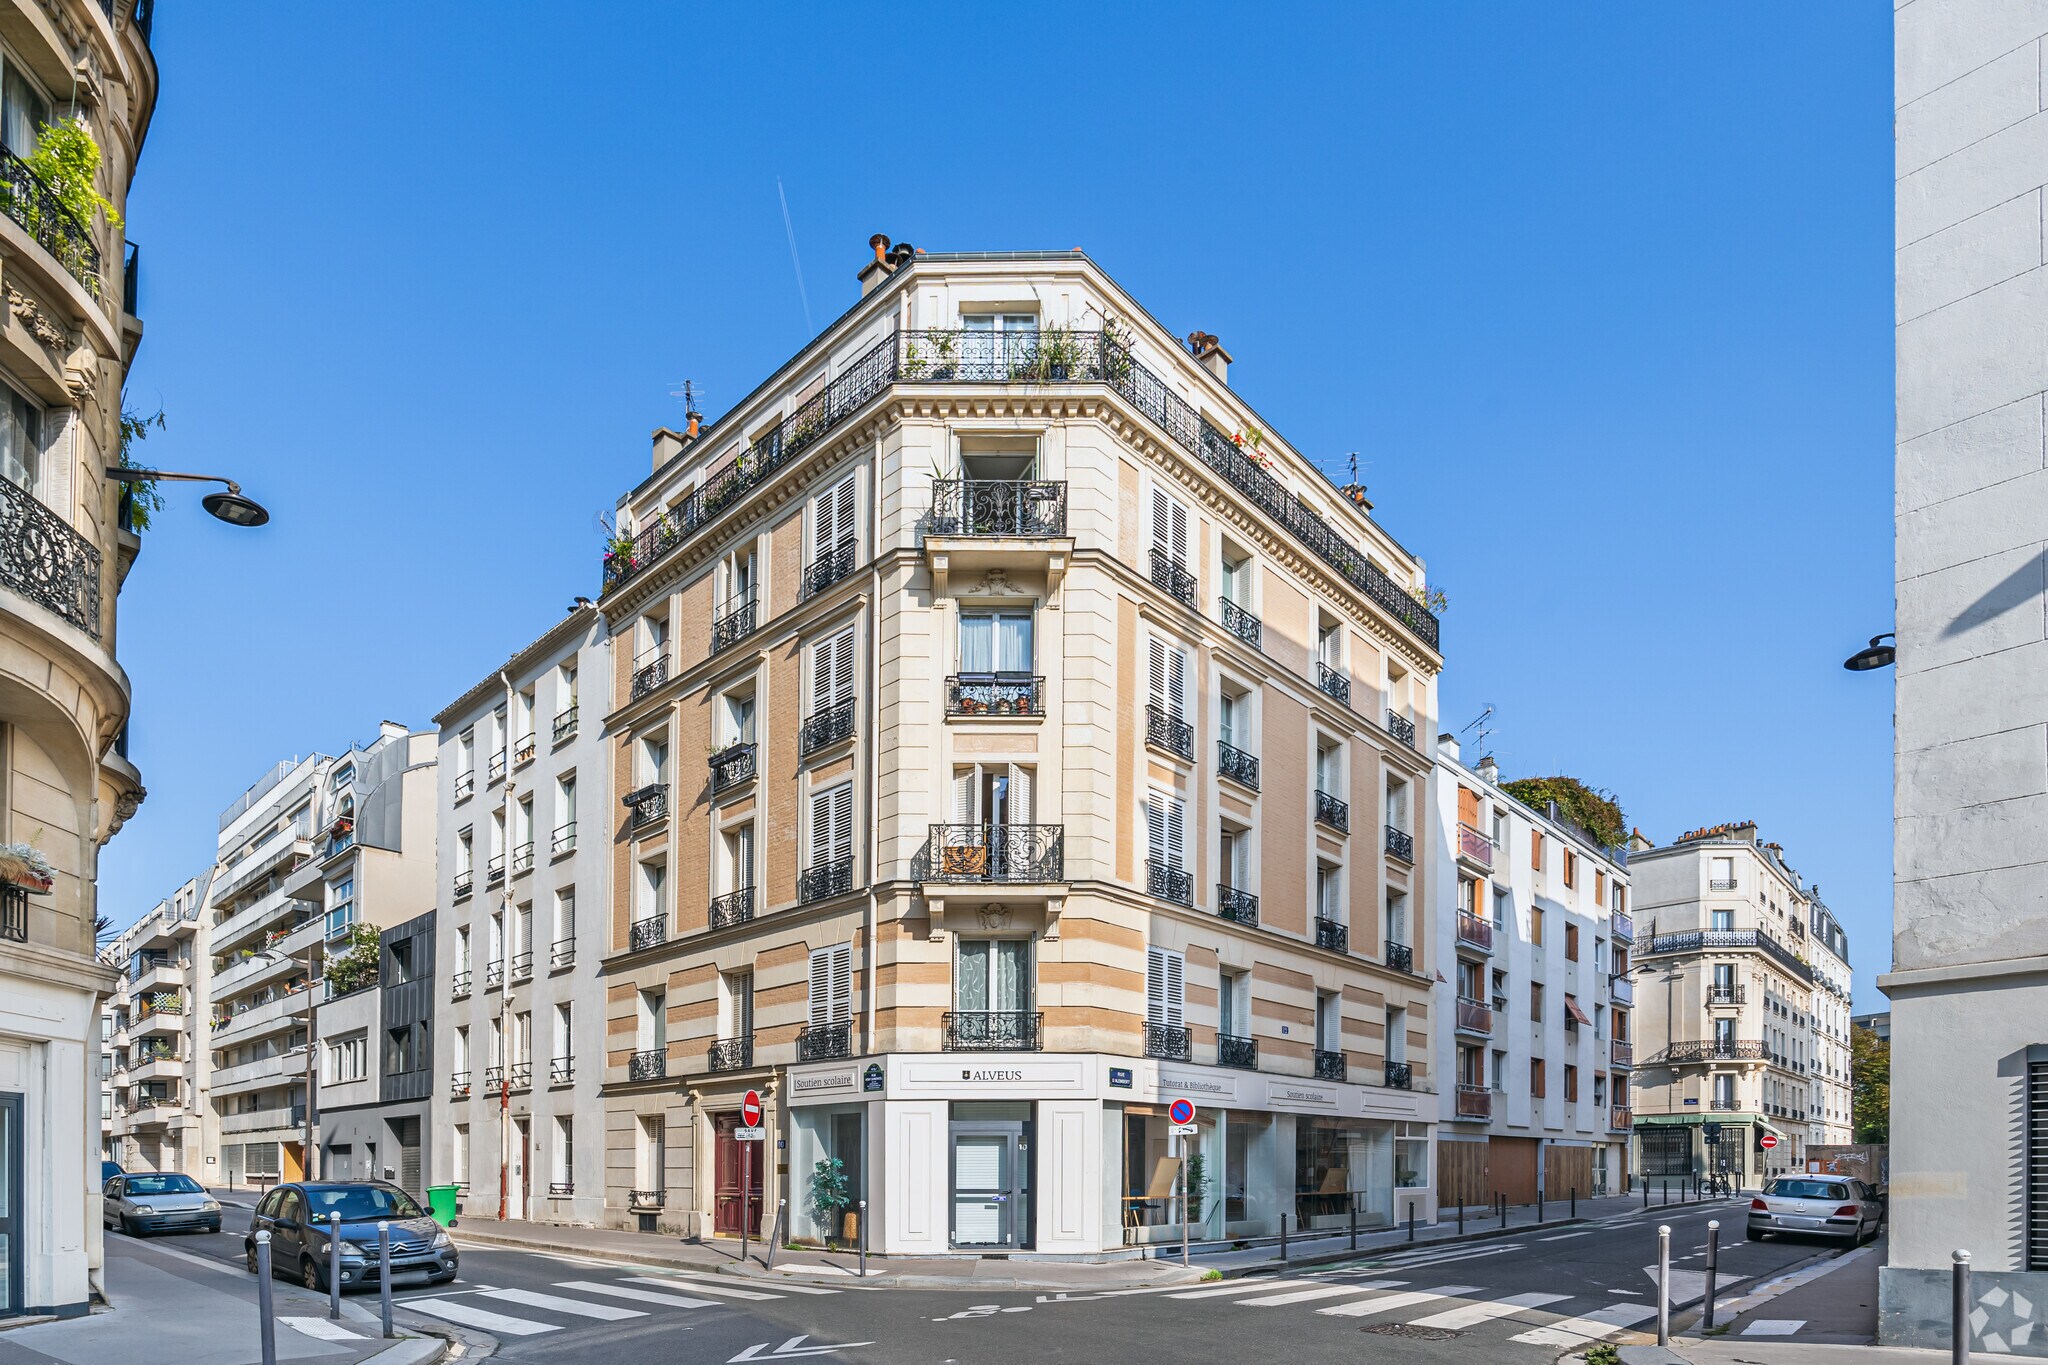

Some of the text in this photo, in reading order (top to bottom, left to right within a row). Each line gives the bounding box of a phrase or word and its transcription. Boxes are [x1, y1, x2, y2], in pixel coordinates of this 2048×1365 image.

[796, 1075, 851, 1088] Soutien scolaire
[973, 1070, 1022, 1081] ALVEUS
[1163, 1079, 1221, 1092] Tutorat & Bibliothèque
[1286, 1090, 1324, 1101] Soutien scolaire
